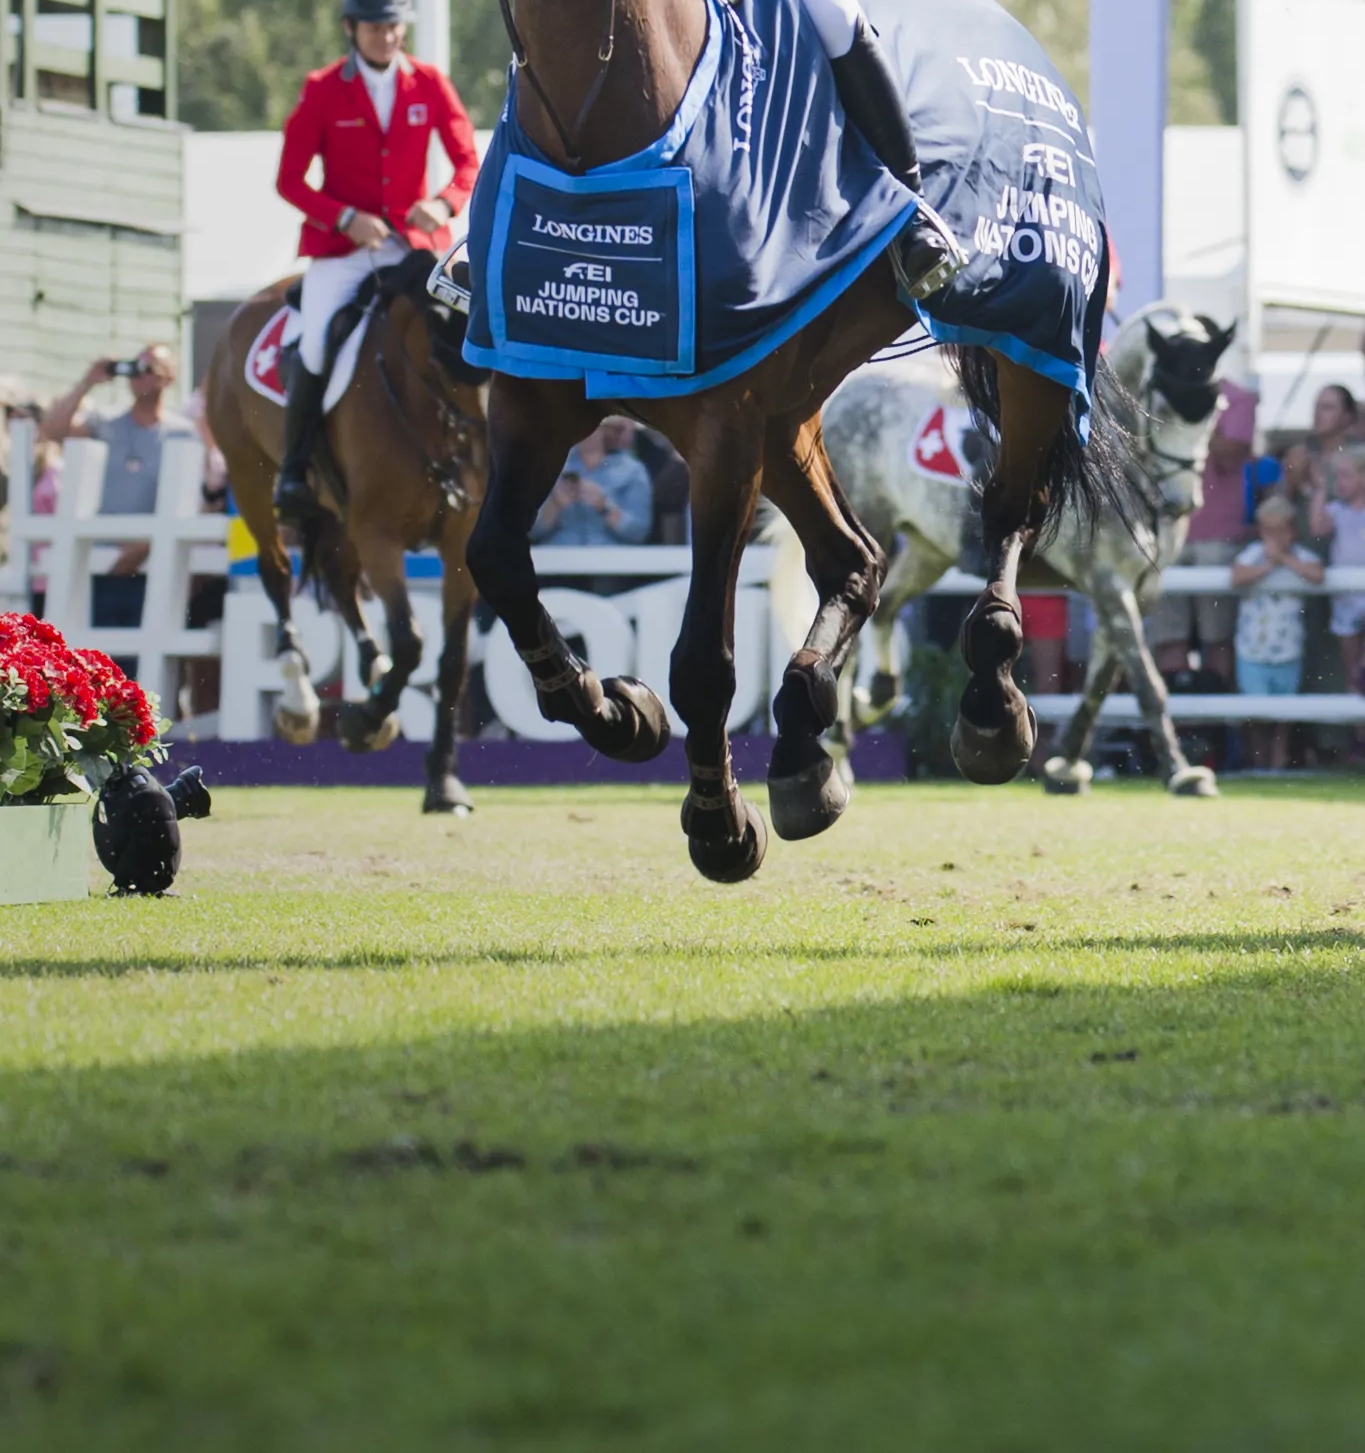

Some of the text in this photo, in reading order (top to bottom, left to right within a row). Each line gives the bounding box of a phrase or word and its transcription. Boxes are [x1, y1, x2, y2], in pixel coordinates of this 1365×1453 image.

[532, 213, 653, 245] LONGINES
[974, 215, 1080, 275] NATONS
[563, 262, 612, 283] FEI
[515, 294, 660, 327] NATIONS CUP
[537, 281, 639, 308] JUMPING
